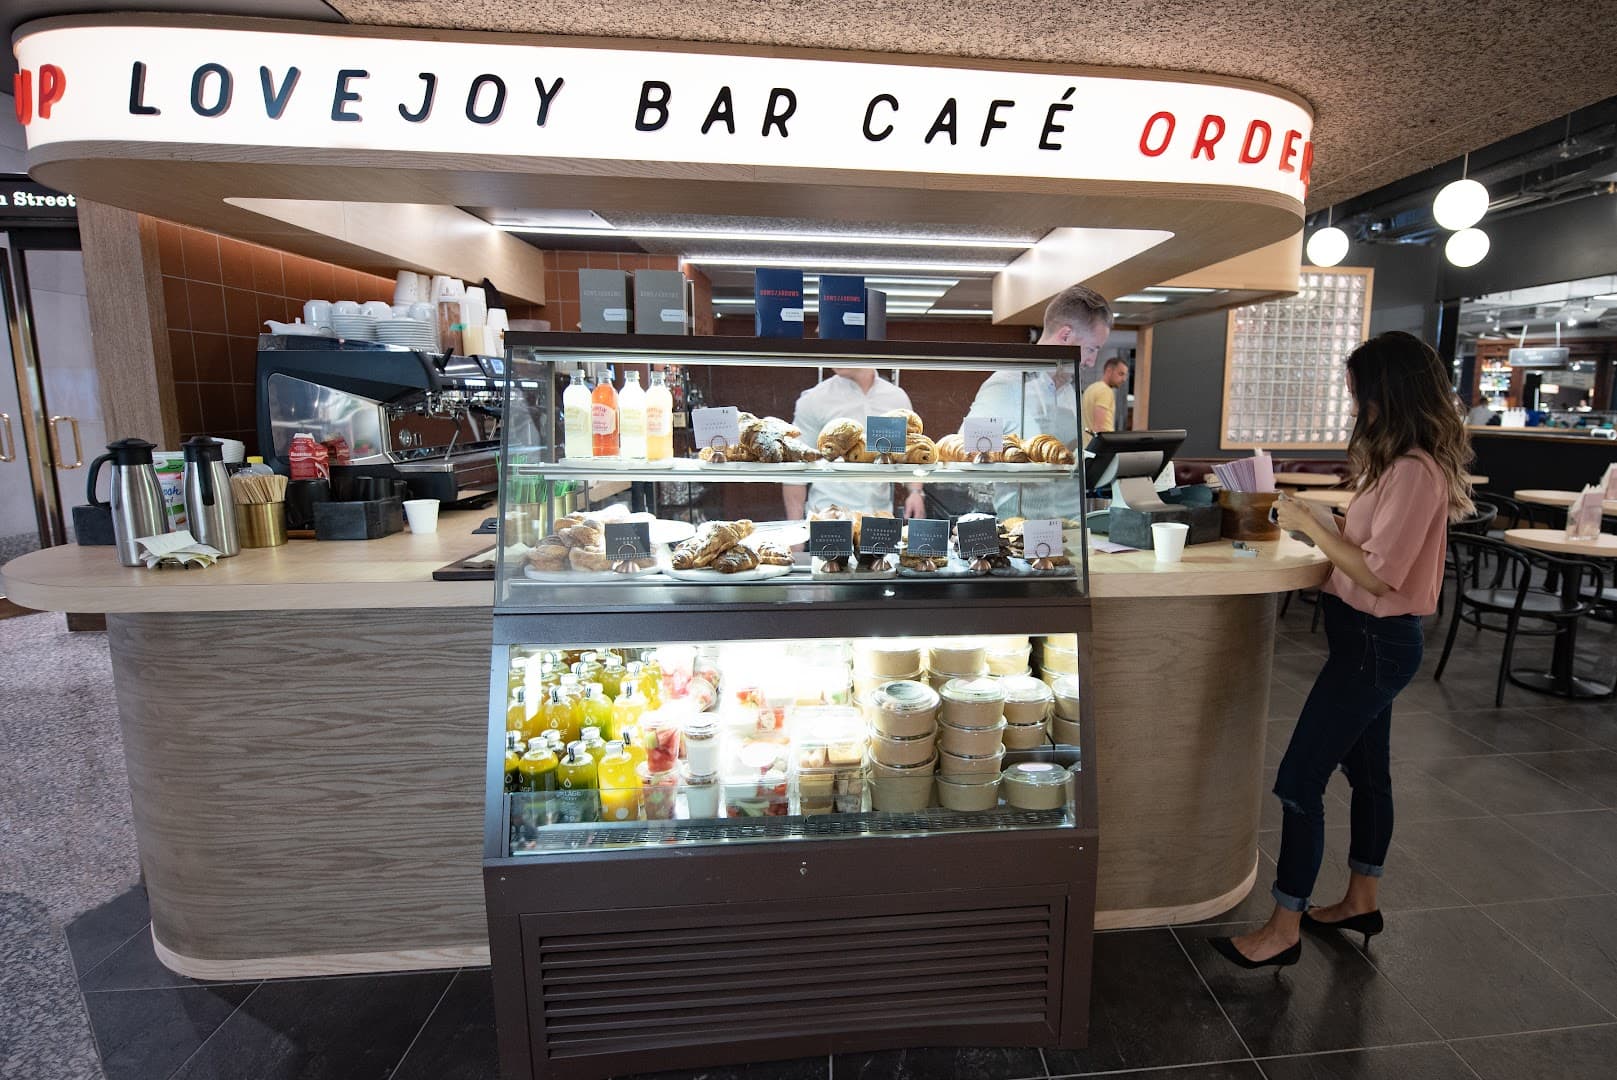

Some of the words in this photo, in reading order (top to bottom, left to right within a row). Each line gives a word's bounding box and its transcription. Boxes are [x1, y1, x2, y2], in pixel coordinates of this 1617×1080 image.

[13, 64, 66, 126] UP
[129, 62, 565, 126] LOVEJOY
[634, 80, 797, 137] BAR
[862, 87, 1076, 150] CAFÉ
[13, 191, 76, 207] Street
